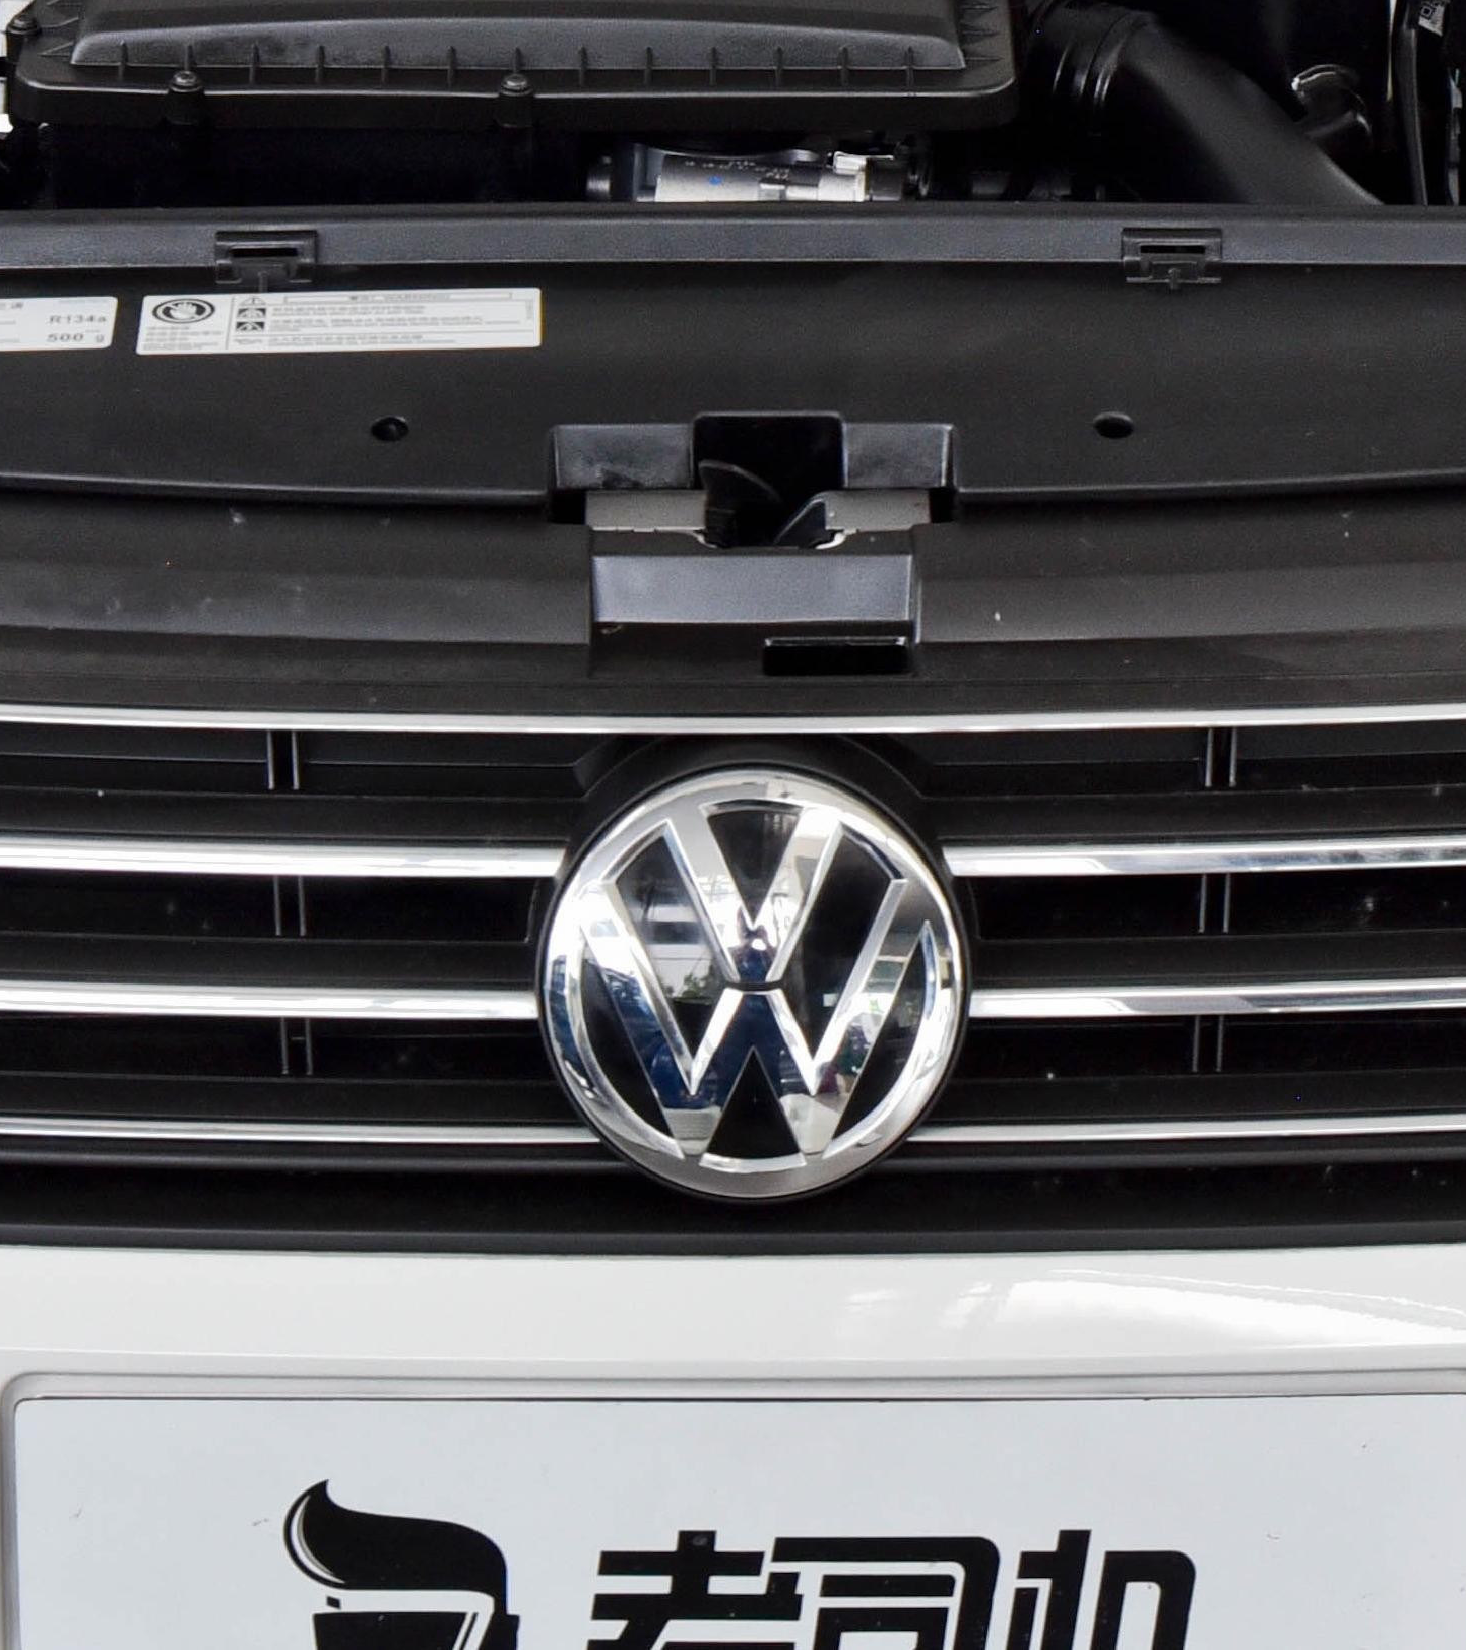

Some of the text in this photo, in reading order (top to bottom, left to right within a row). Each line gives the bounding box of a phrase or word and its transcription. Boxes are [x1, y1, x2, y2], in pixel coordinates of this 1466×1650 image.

[49, 314, 107, 324] R134a
[47, 333, 105, 343] 500 g
